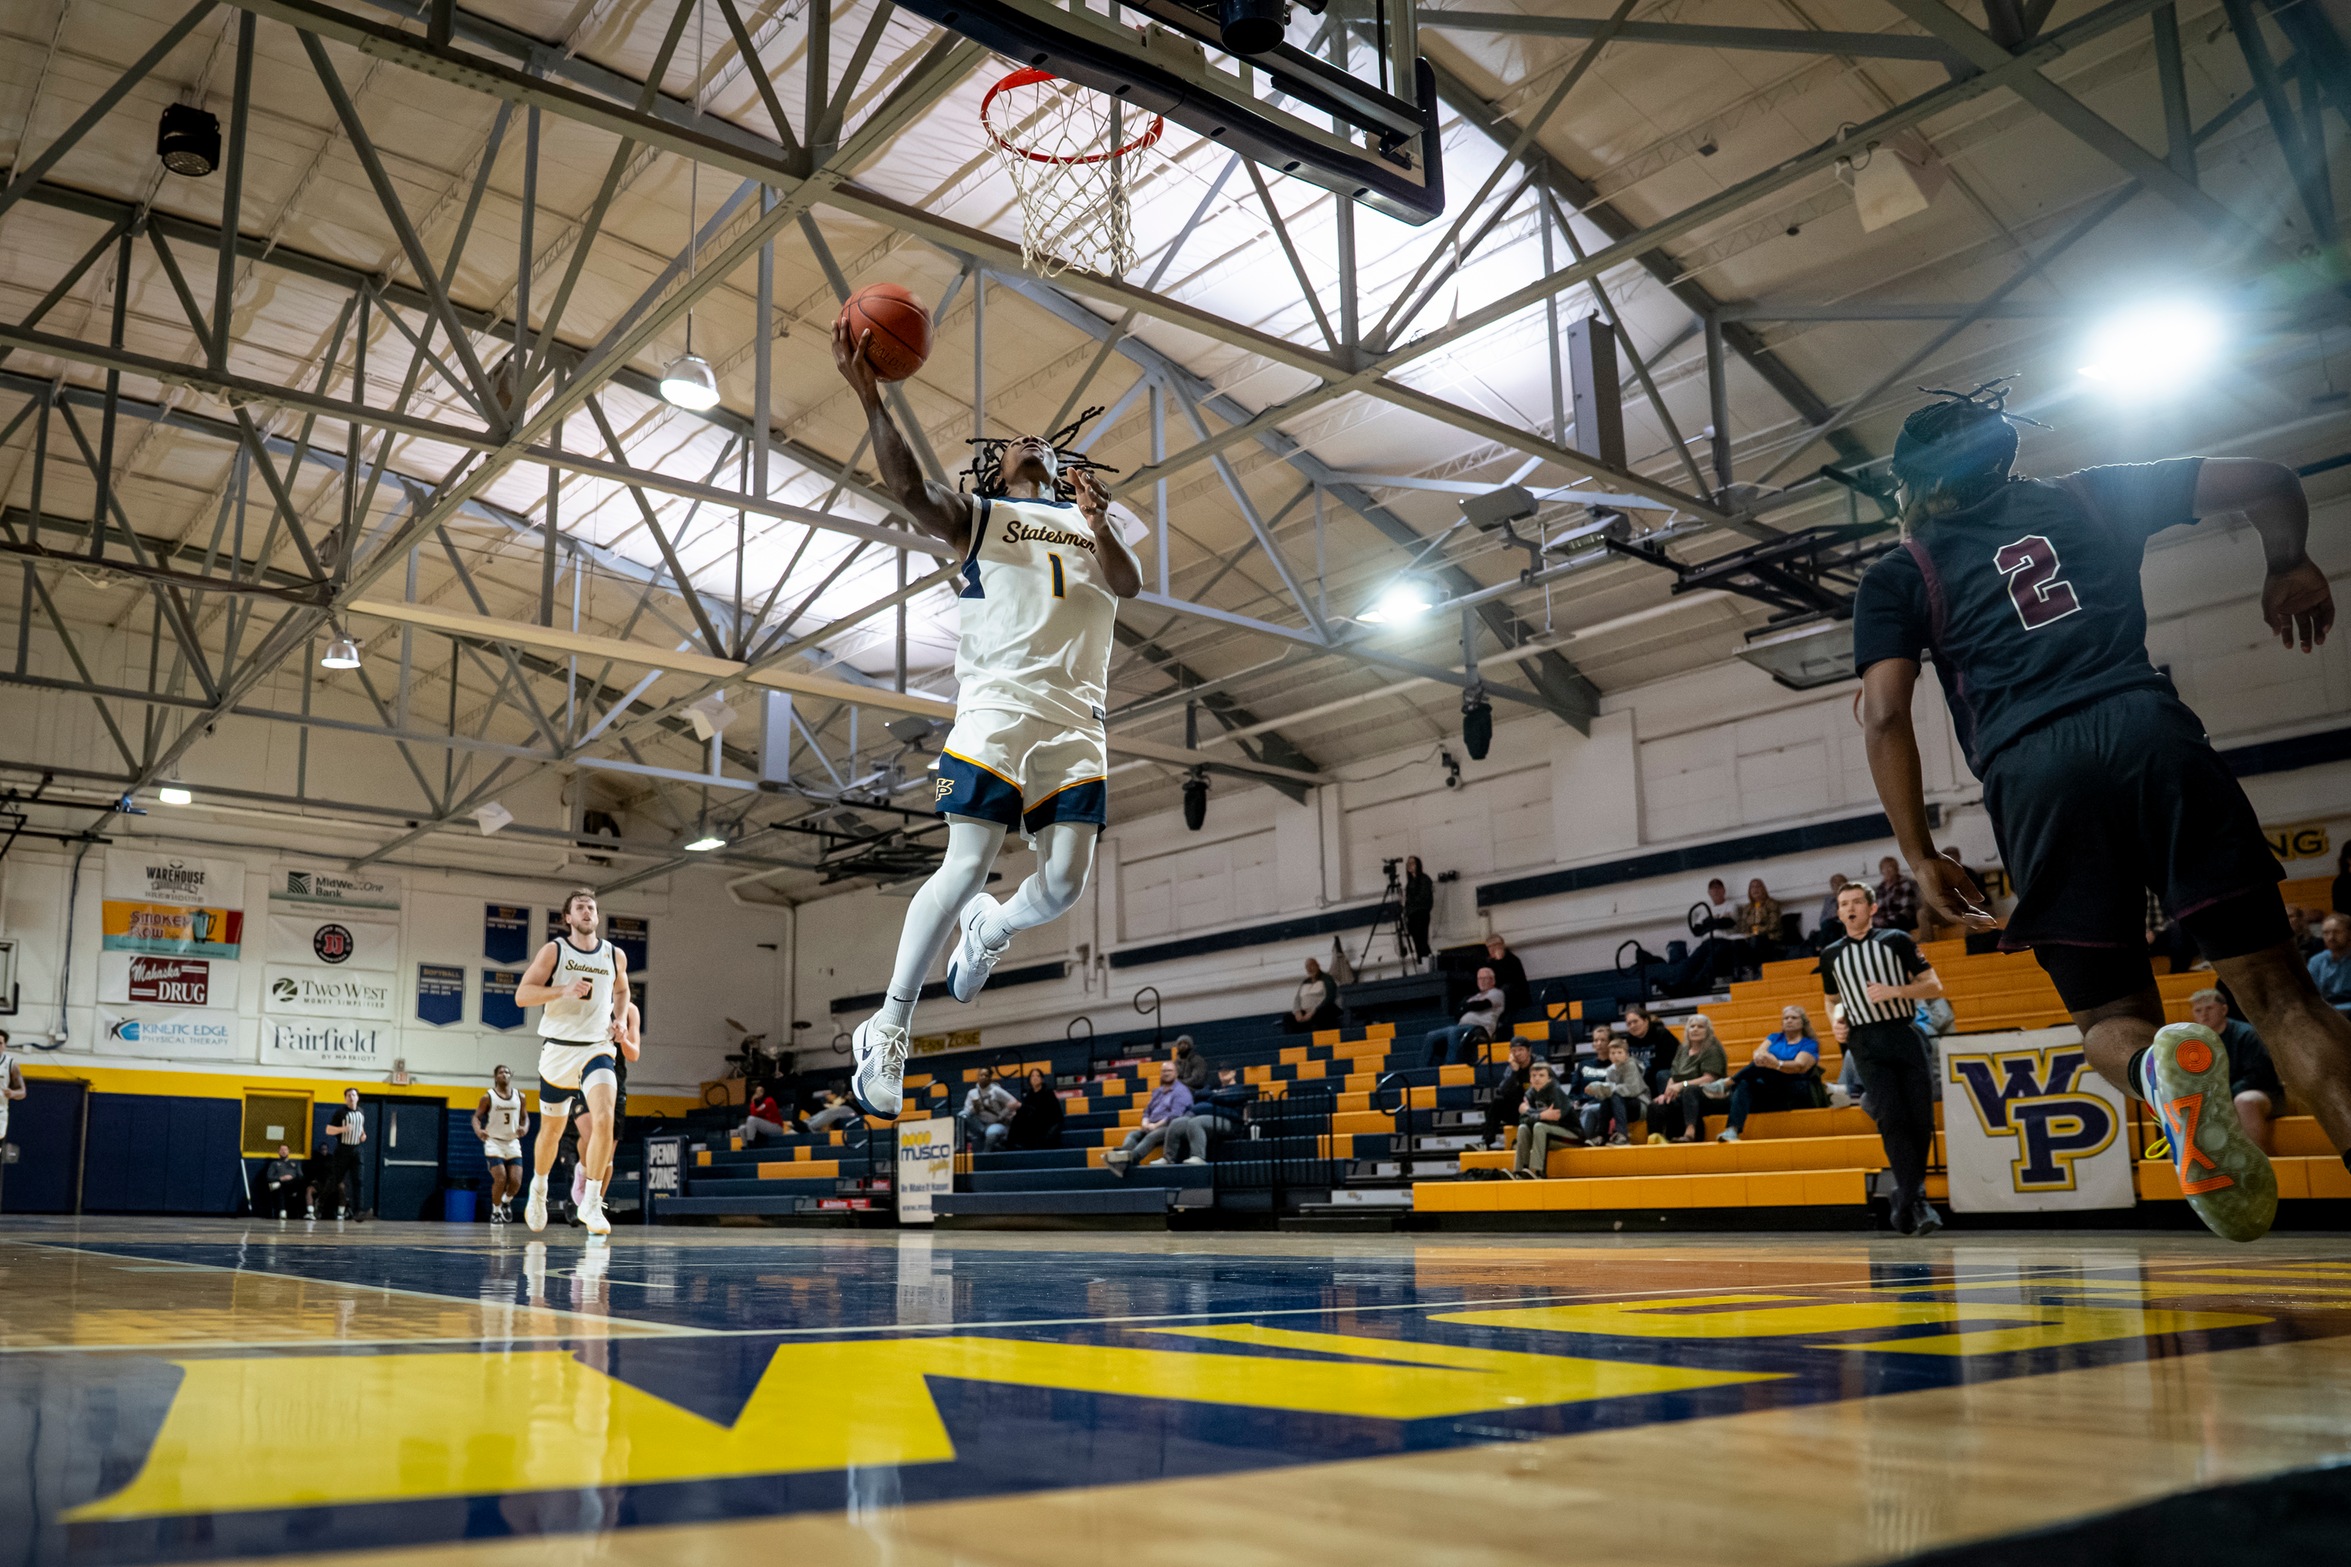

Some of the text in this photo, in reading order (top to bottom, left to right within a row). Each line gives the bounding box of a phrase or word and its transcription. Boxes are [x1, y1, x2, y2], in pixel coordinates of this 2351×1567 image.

[1003, 520, 1096, 555] Statesmen
[1048, 551, 1066, 599] 1
[1993, 534, 2082, 631] 2
[146, 866, 205, 884] WAREHOUSE
[316, 877, 384, 893] MidWeOne
[316, 887, 342, 898] Bank
[131, 963, 180, 982] Mahaska
[565, 959, 610, 976] Statesmen
[158, 981, 206, 1003] DRUG
[142, 1023, 229, 1037] KINETIC EDGE
[274, 1025, 377, 1054] Fairfield
[142, 1036, 229, 1046] PHYSICAL THERAPY
[504, 1112, 510, 1125] 3
[650, 1143, 678, 1165] PENN
[649, 1167, 678, 1189] ZONE
